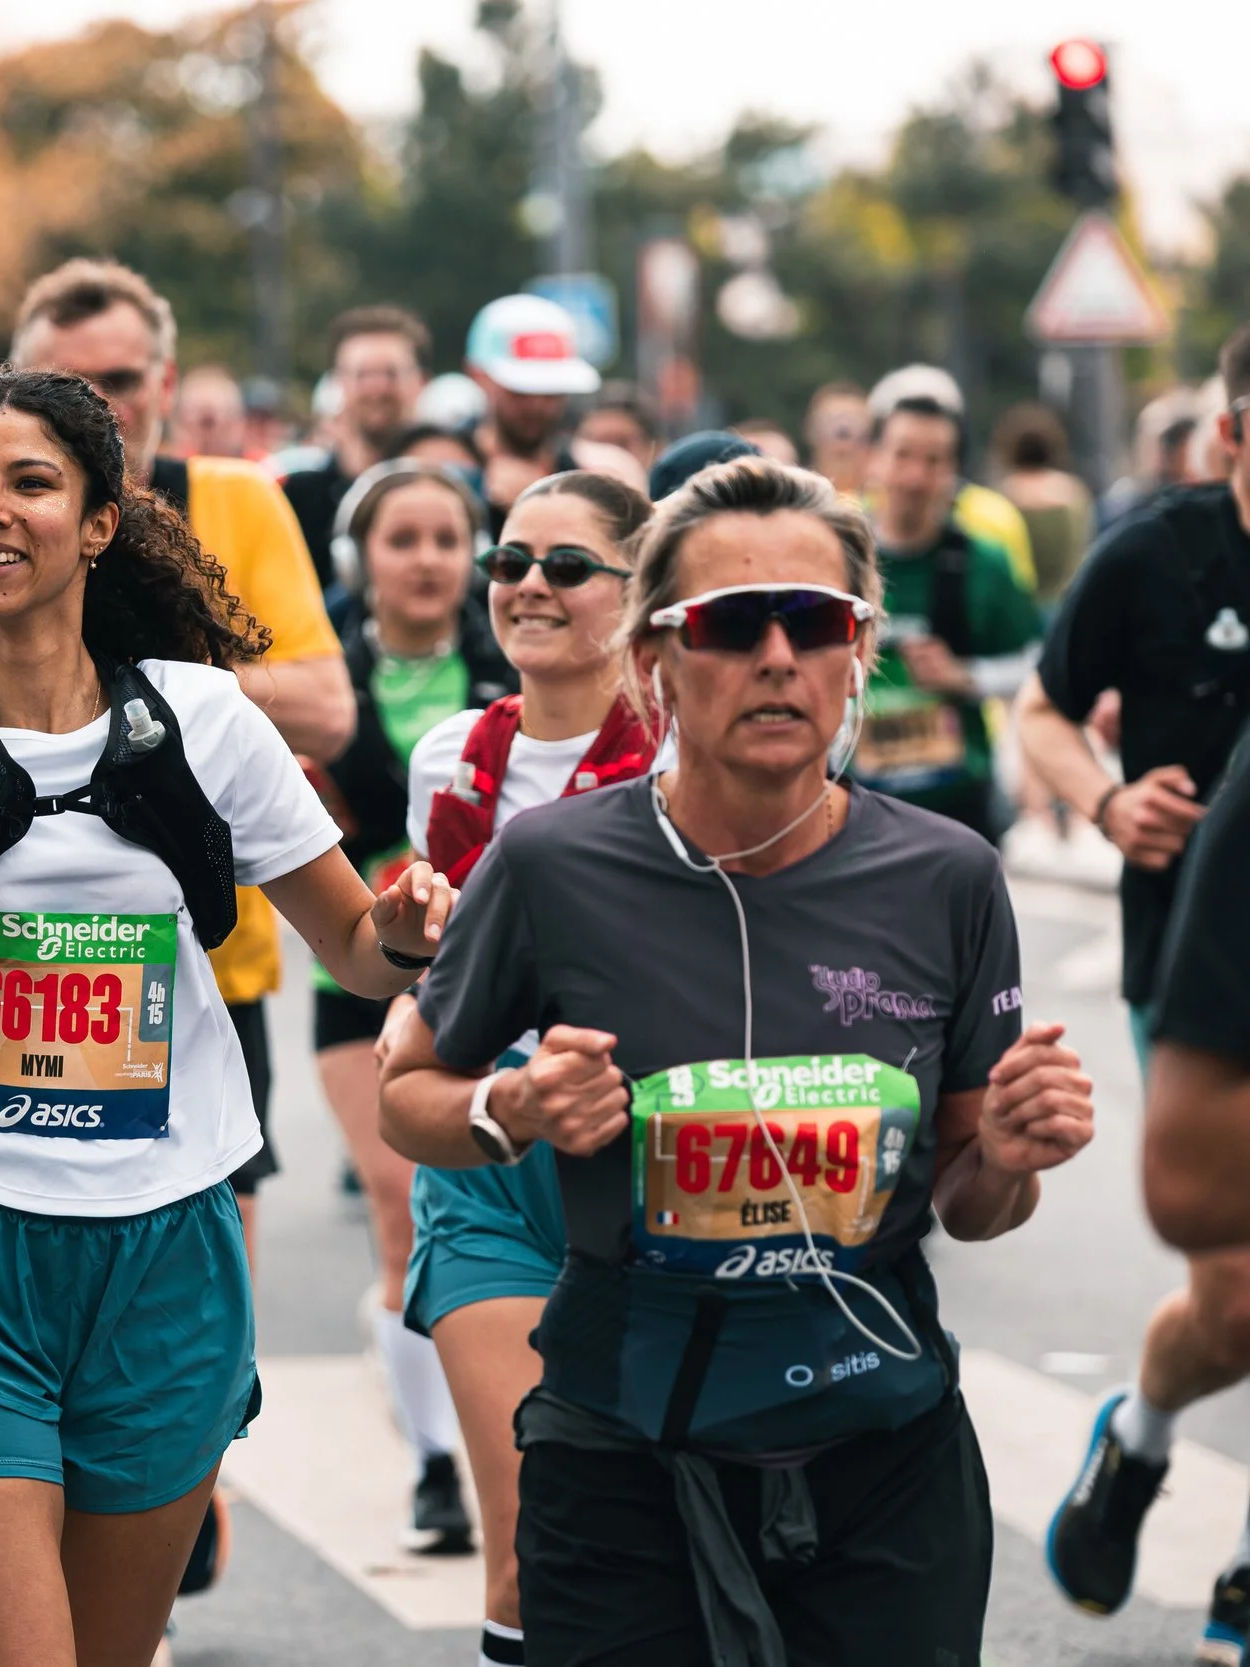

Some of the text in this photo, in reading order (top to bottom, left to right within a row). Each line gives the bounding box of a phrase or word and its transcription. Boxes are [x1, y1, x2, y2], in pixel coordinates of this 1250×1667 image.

[1, 913, 150, 942] Schneider
[65, 942, 146, 958] Electric
[147, 981, 166, 1003] 4h
[147, 1003, 165, 1025] 15
[20, 1053, 64, 1078] MYMI
[707, 1055, 882, 1089] Schneider
[784, 1086, 882, 1106] Electric
[675, 1119, 860, 1194] 67649
[740, 1197, 791, 1227] ÉLISE
